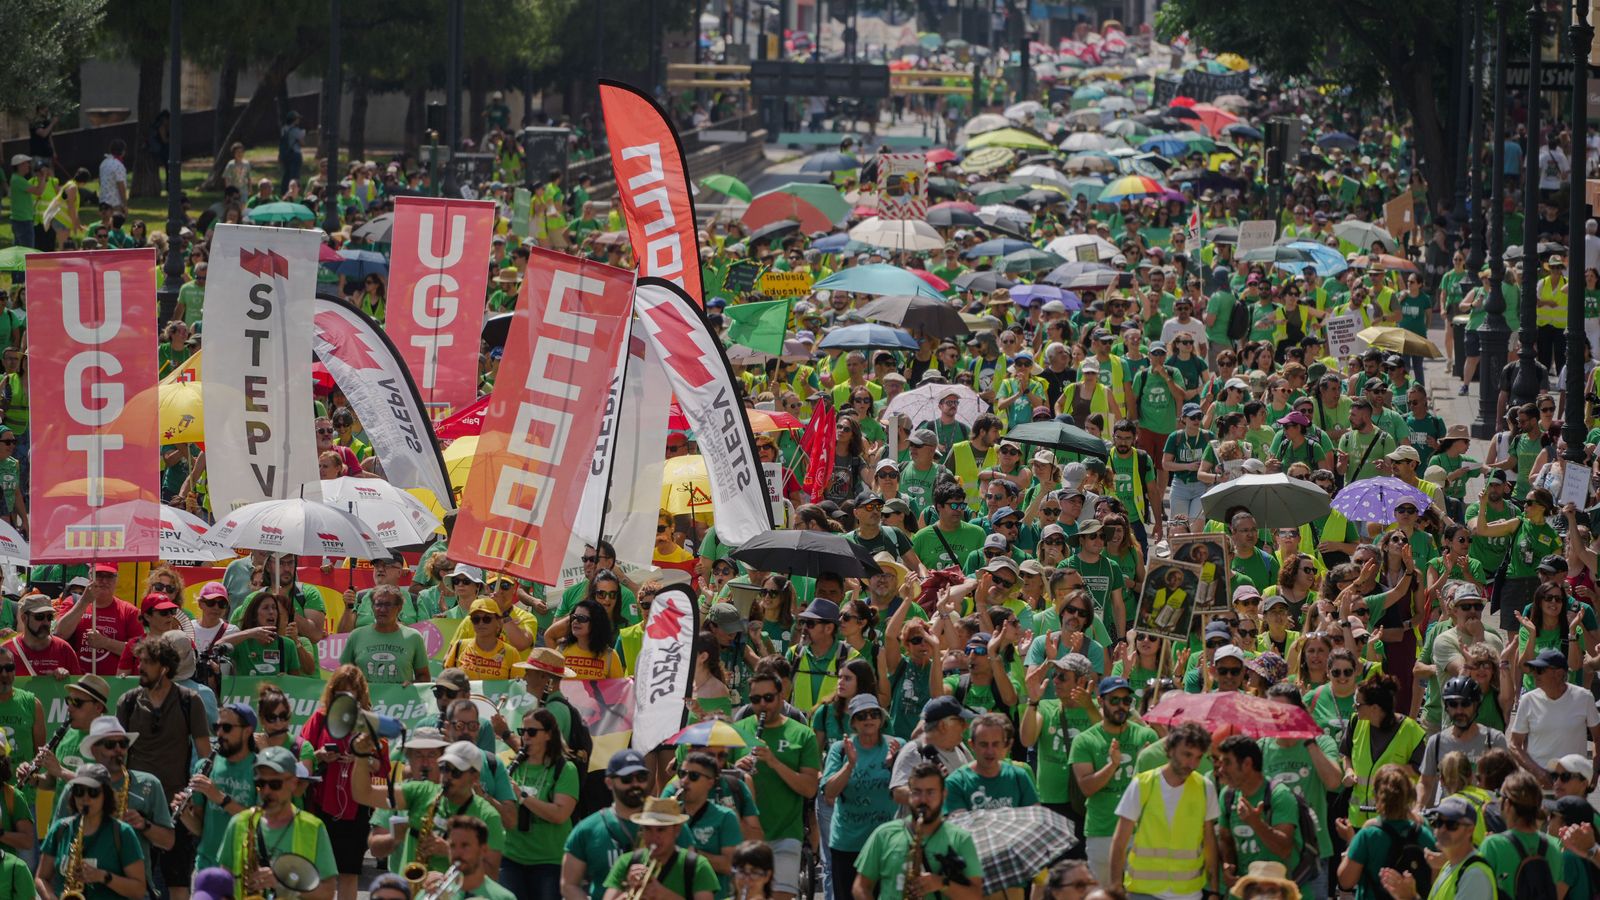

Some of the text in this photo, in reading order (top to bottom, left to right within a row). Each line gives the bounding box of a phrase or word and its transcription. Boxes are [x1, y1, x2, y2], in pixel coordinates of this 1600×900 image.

[61, 270, 125, 507] UGT
[409, 213, 467, 389] UGT
[244, 283, 278, 498] STEPV
[490, 269, 606, 528] CCOO
[140, 529, 181, 540] STEPV
[259, 533, 285, 541] STEPV
[778, 741, 790, 752] P
